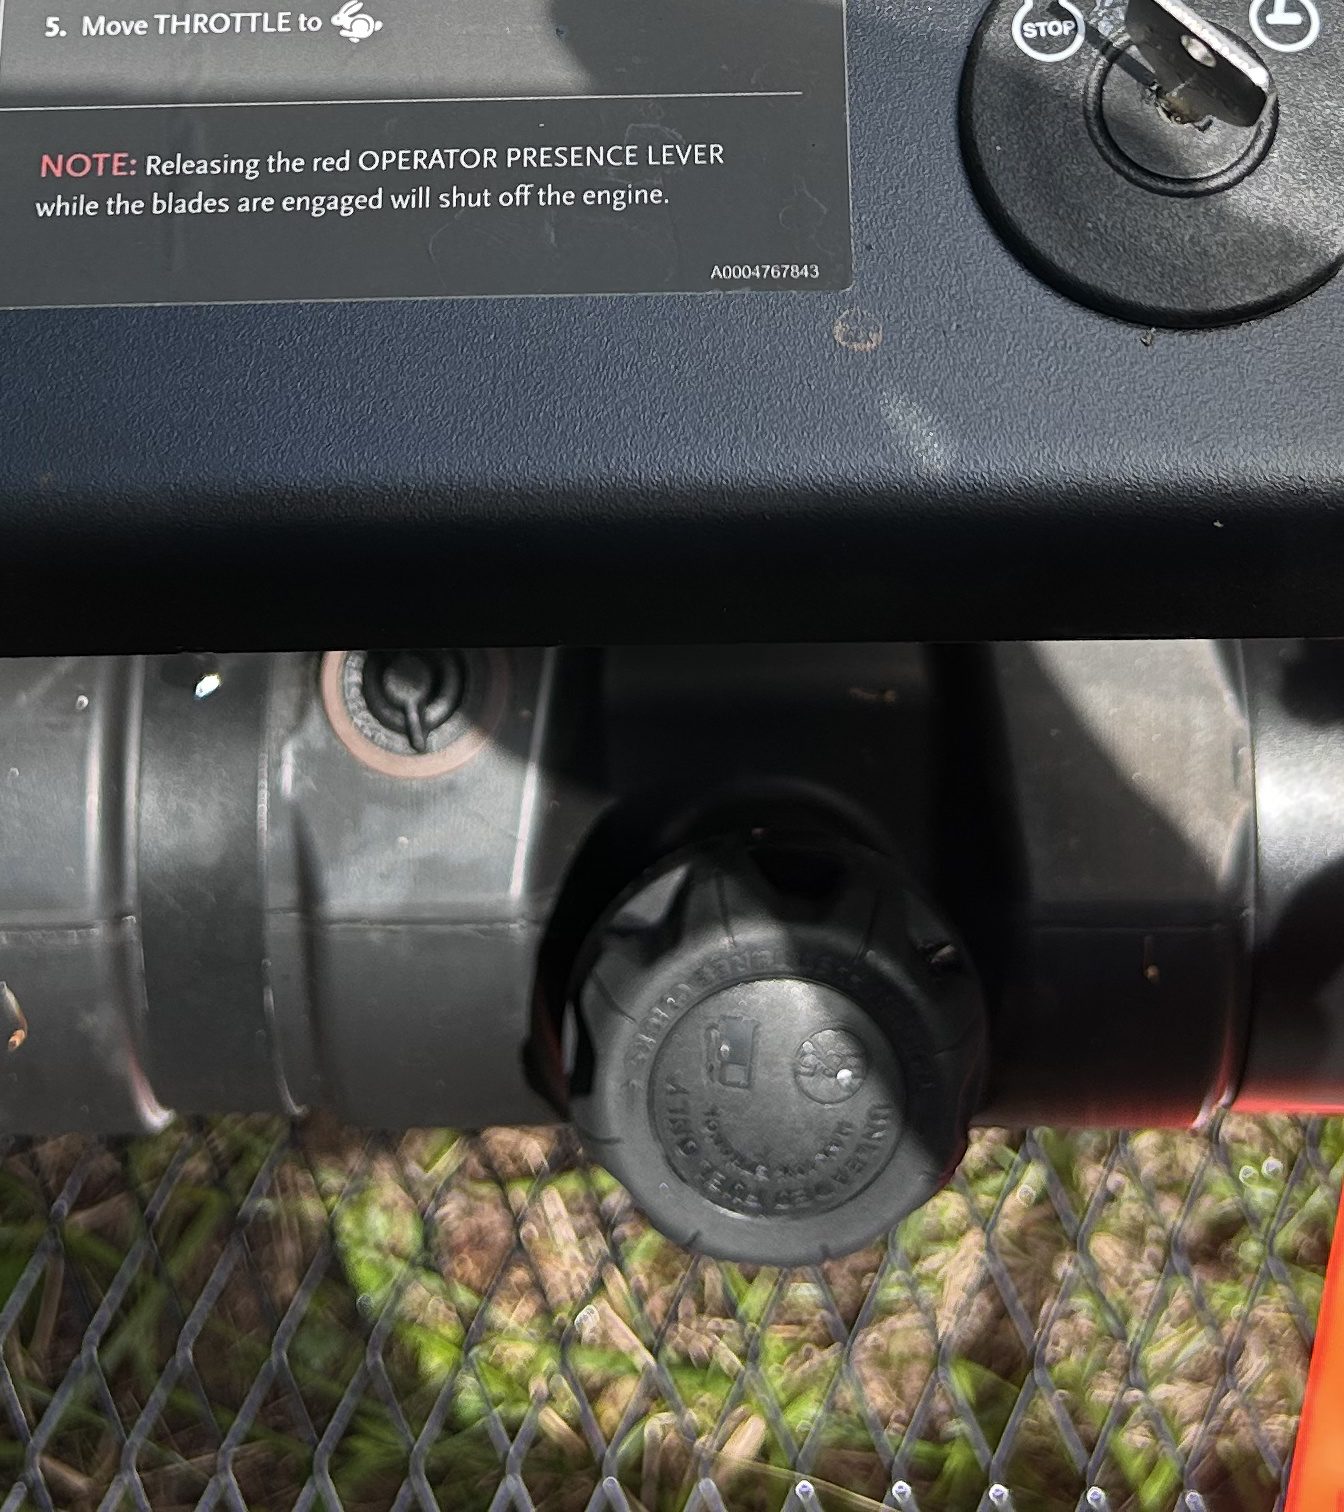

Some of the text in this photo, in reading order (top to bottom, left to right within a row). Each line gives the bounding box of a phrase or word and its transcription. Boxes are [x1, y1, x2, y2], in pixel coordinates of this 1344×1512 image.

[1022, 20, 1076, 38] STOP
[42, 144, 723, 180] NOTE: Releasing the red OPERATOR PRESENCE LEVER
[36, 184, 668, 217] while the blades are engaged will shut off the engine.
[711, 265, 819, 278] A0004767843
